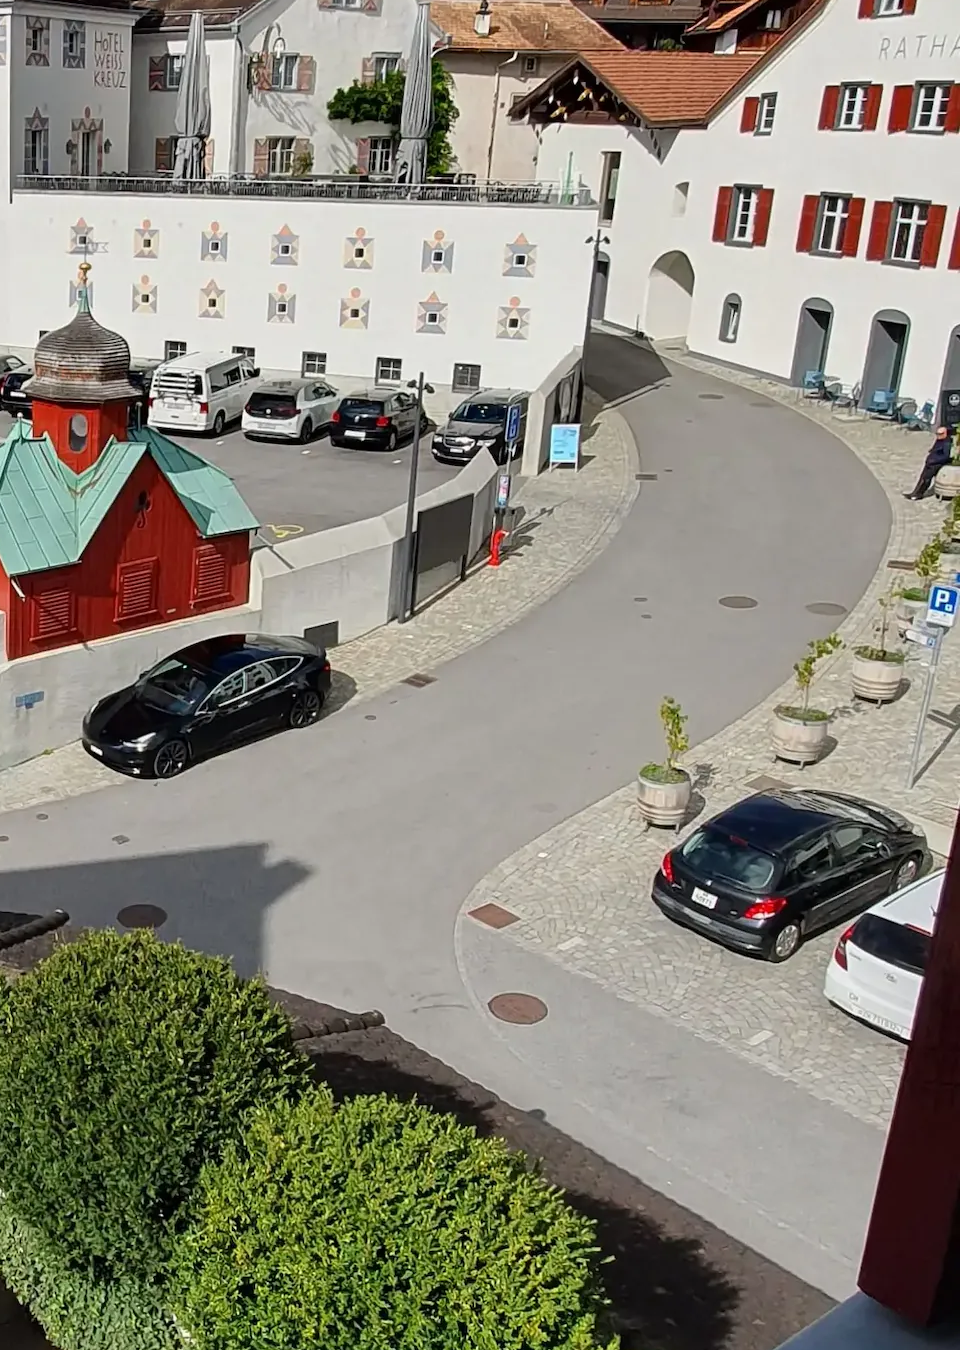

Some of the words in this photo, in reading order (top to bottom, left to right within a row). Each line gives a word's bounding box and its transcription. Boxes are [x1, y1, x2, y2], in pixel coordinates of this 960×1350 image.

[94, 52, 123, 70] WEISS
[94, 70, 127, 88] KREUZ
[935, 590, 951, 608] P
